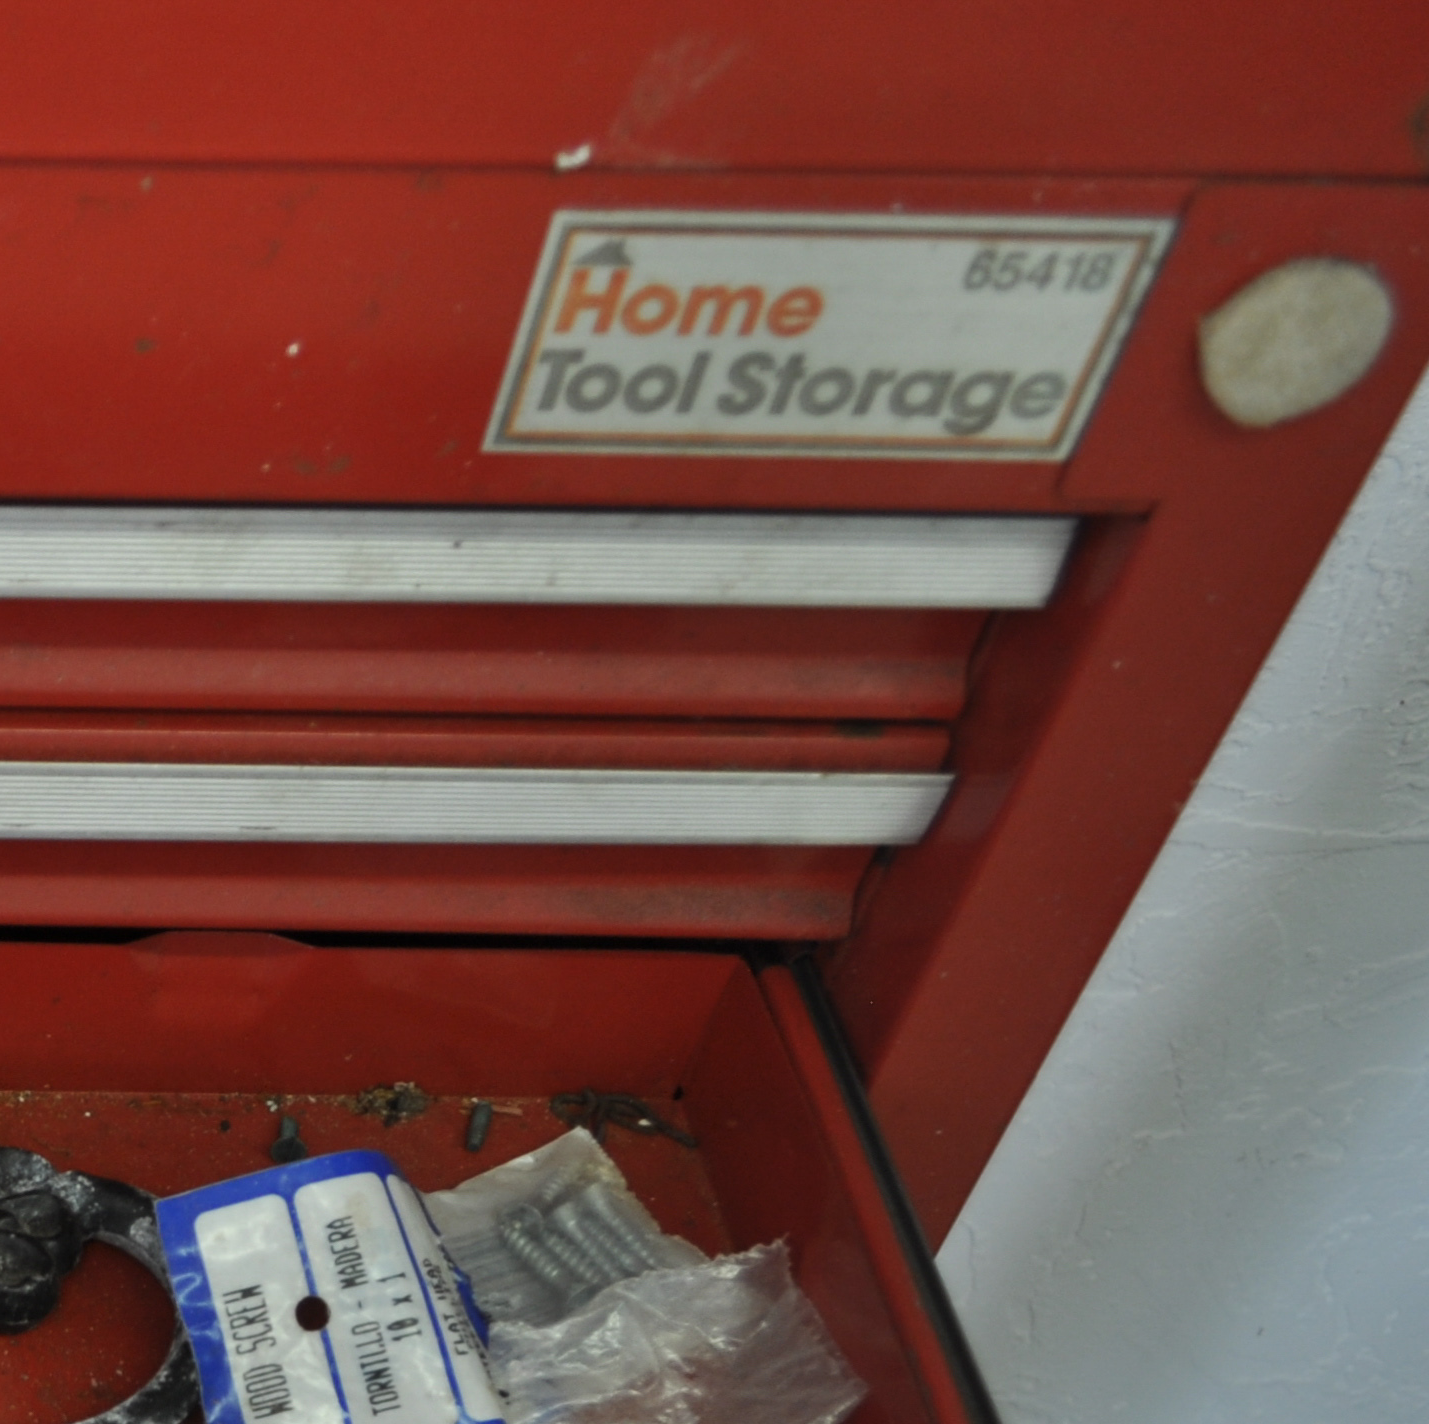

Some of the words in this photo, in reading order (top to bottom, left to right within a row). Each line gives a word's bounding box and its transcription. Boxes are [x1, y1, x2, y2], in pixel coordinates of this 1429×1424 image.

[553, 266, 824, 337] Home
[963, 249, 1115, 292] 65418
[538, 348, 711, 413] Tool
[718, 352, 1066, 436] Storage
[326, 1215, 369, 1290] MADERA
[222, 1283, 277, 1356] SCREW
[386, 1315, 422, 1342] 10
[444, 1313, 470, 1357] FLAT
[243, 1362, 293, 1420] WOOD
[351, 1319, 402, 1416] TORNILLO
